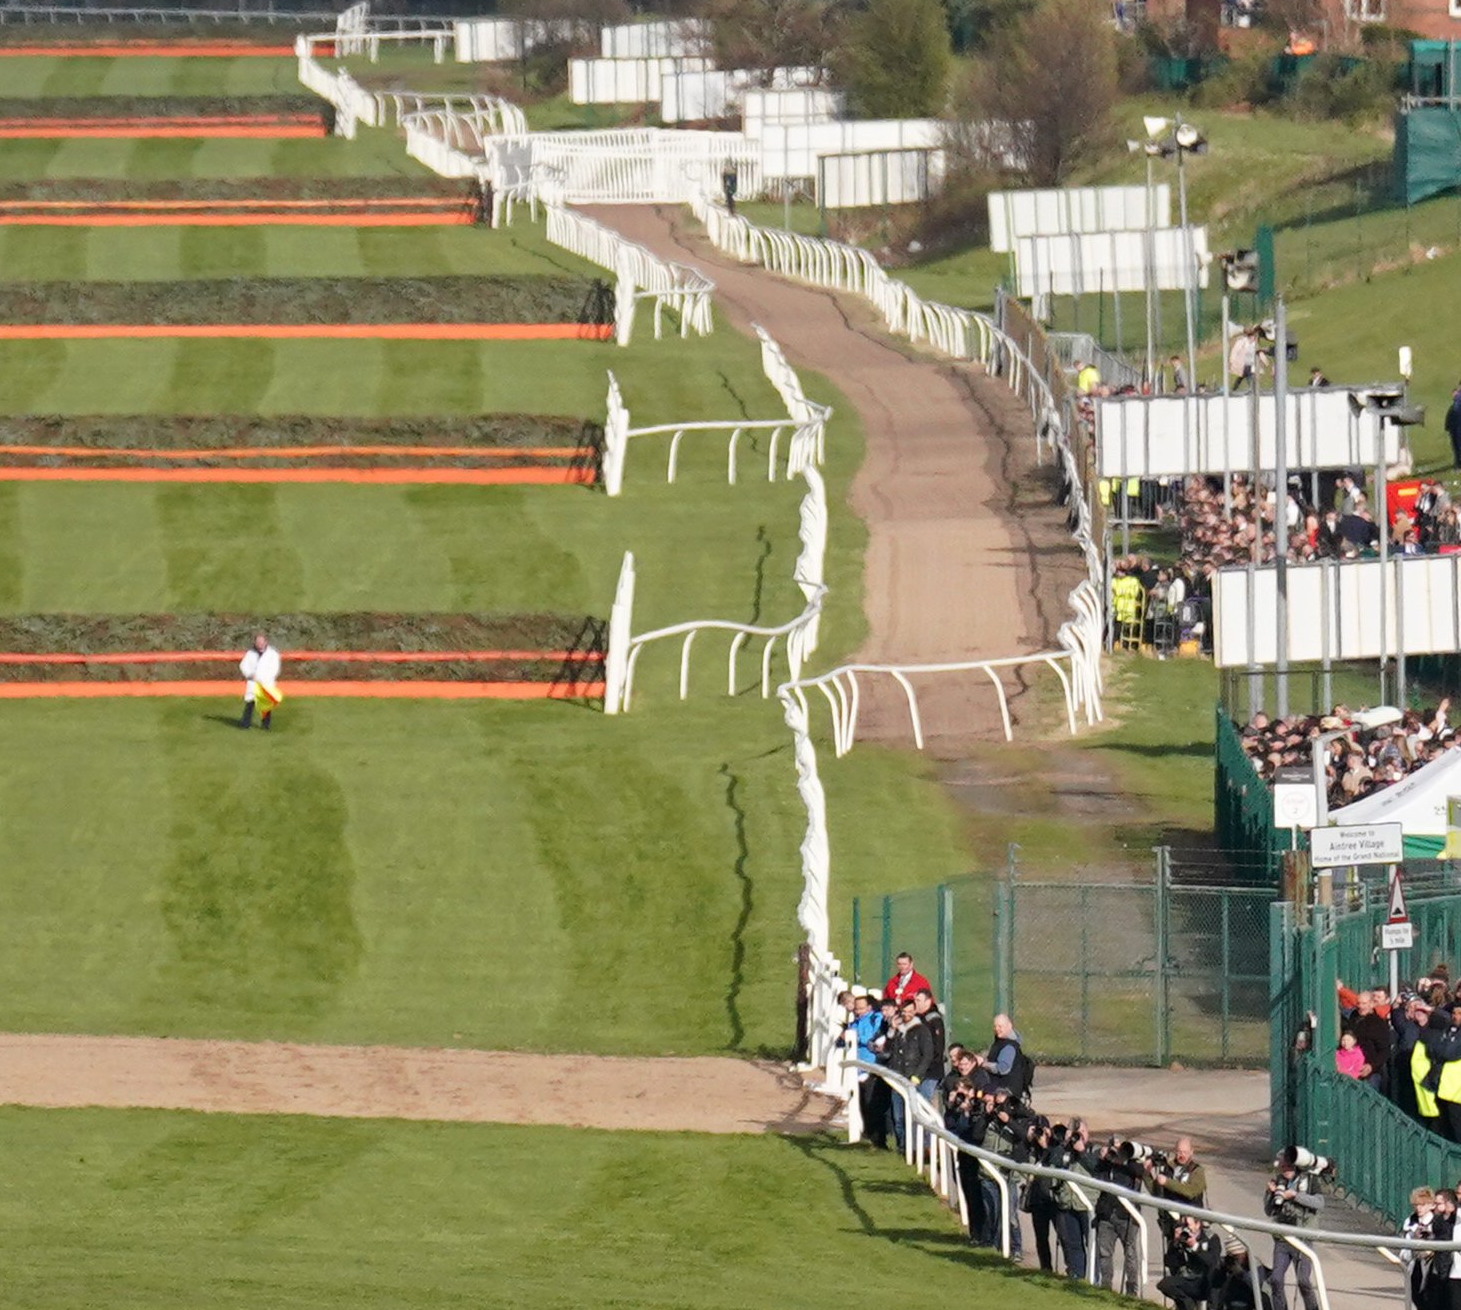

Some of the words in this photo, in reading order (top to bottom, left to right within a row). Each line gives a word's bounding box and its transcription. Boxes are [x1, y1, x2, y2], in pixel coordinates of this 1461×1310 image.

[1329, 841, 1357, 851] Aintree
[1359, 839, 1385, 850] Village
[1353, 852, 1373, 860] Grand
[1373, 850, 1399, 859] National
